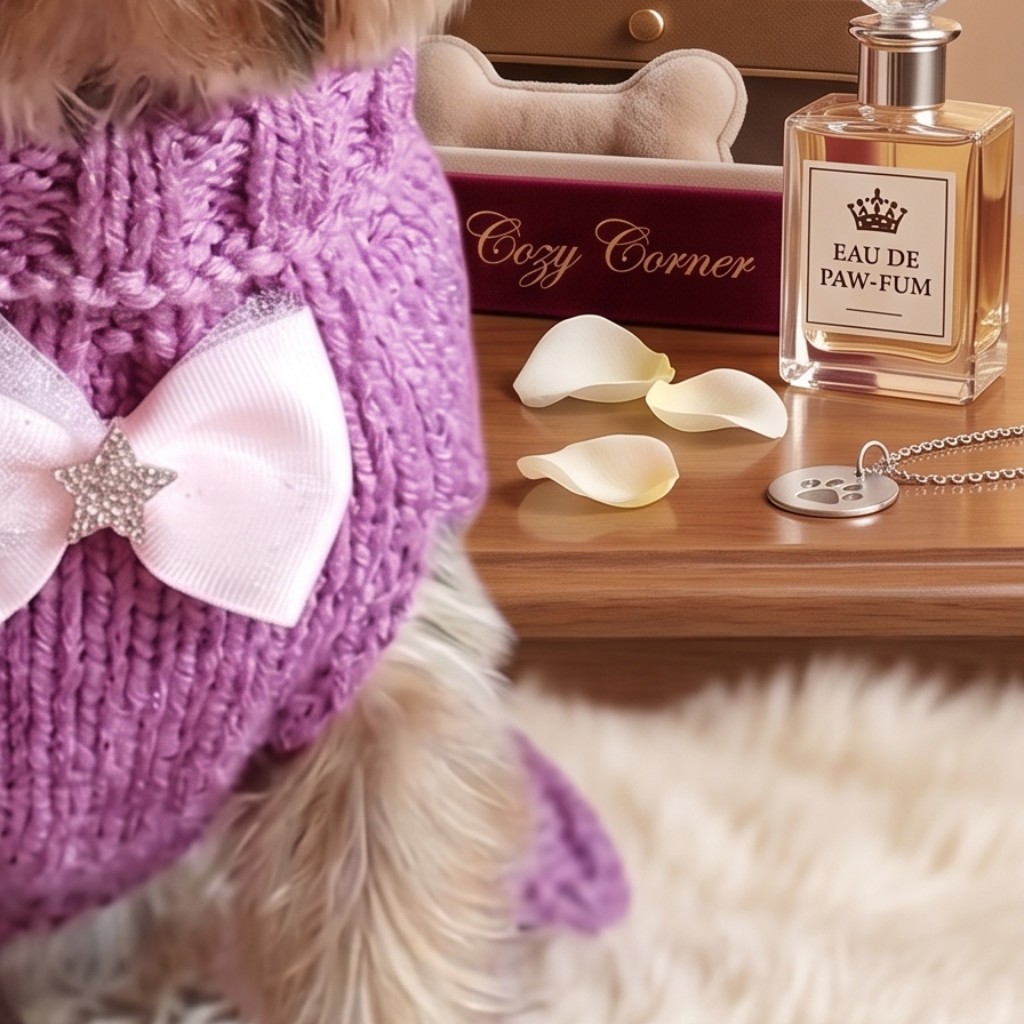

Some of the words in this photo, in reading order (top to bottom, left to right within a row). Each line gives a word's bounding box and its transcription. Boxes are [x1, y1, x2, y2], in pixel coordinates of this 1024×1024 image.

[466, 210, 583, 289] Cozy
[595, 218, 756, 278] Corner
[833, 243, 880, 265] EAU
[887, 248, 919, 269] DE
[820, 268, 931, 296] PAW-FUM
